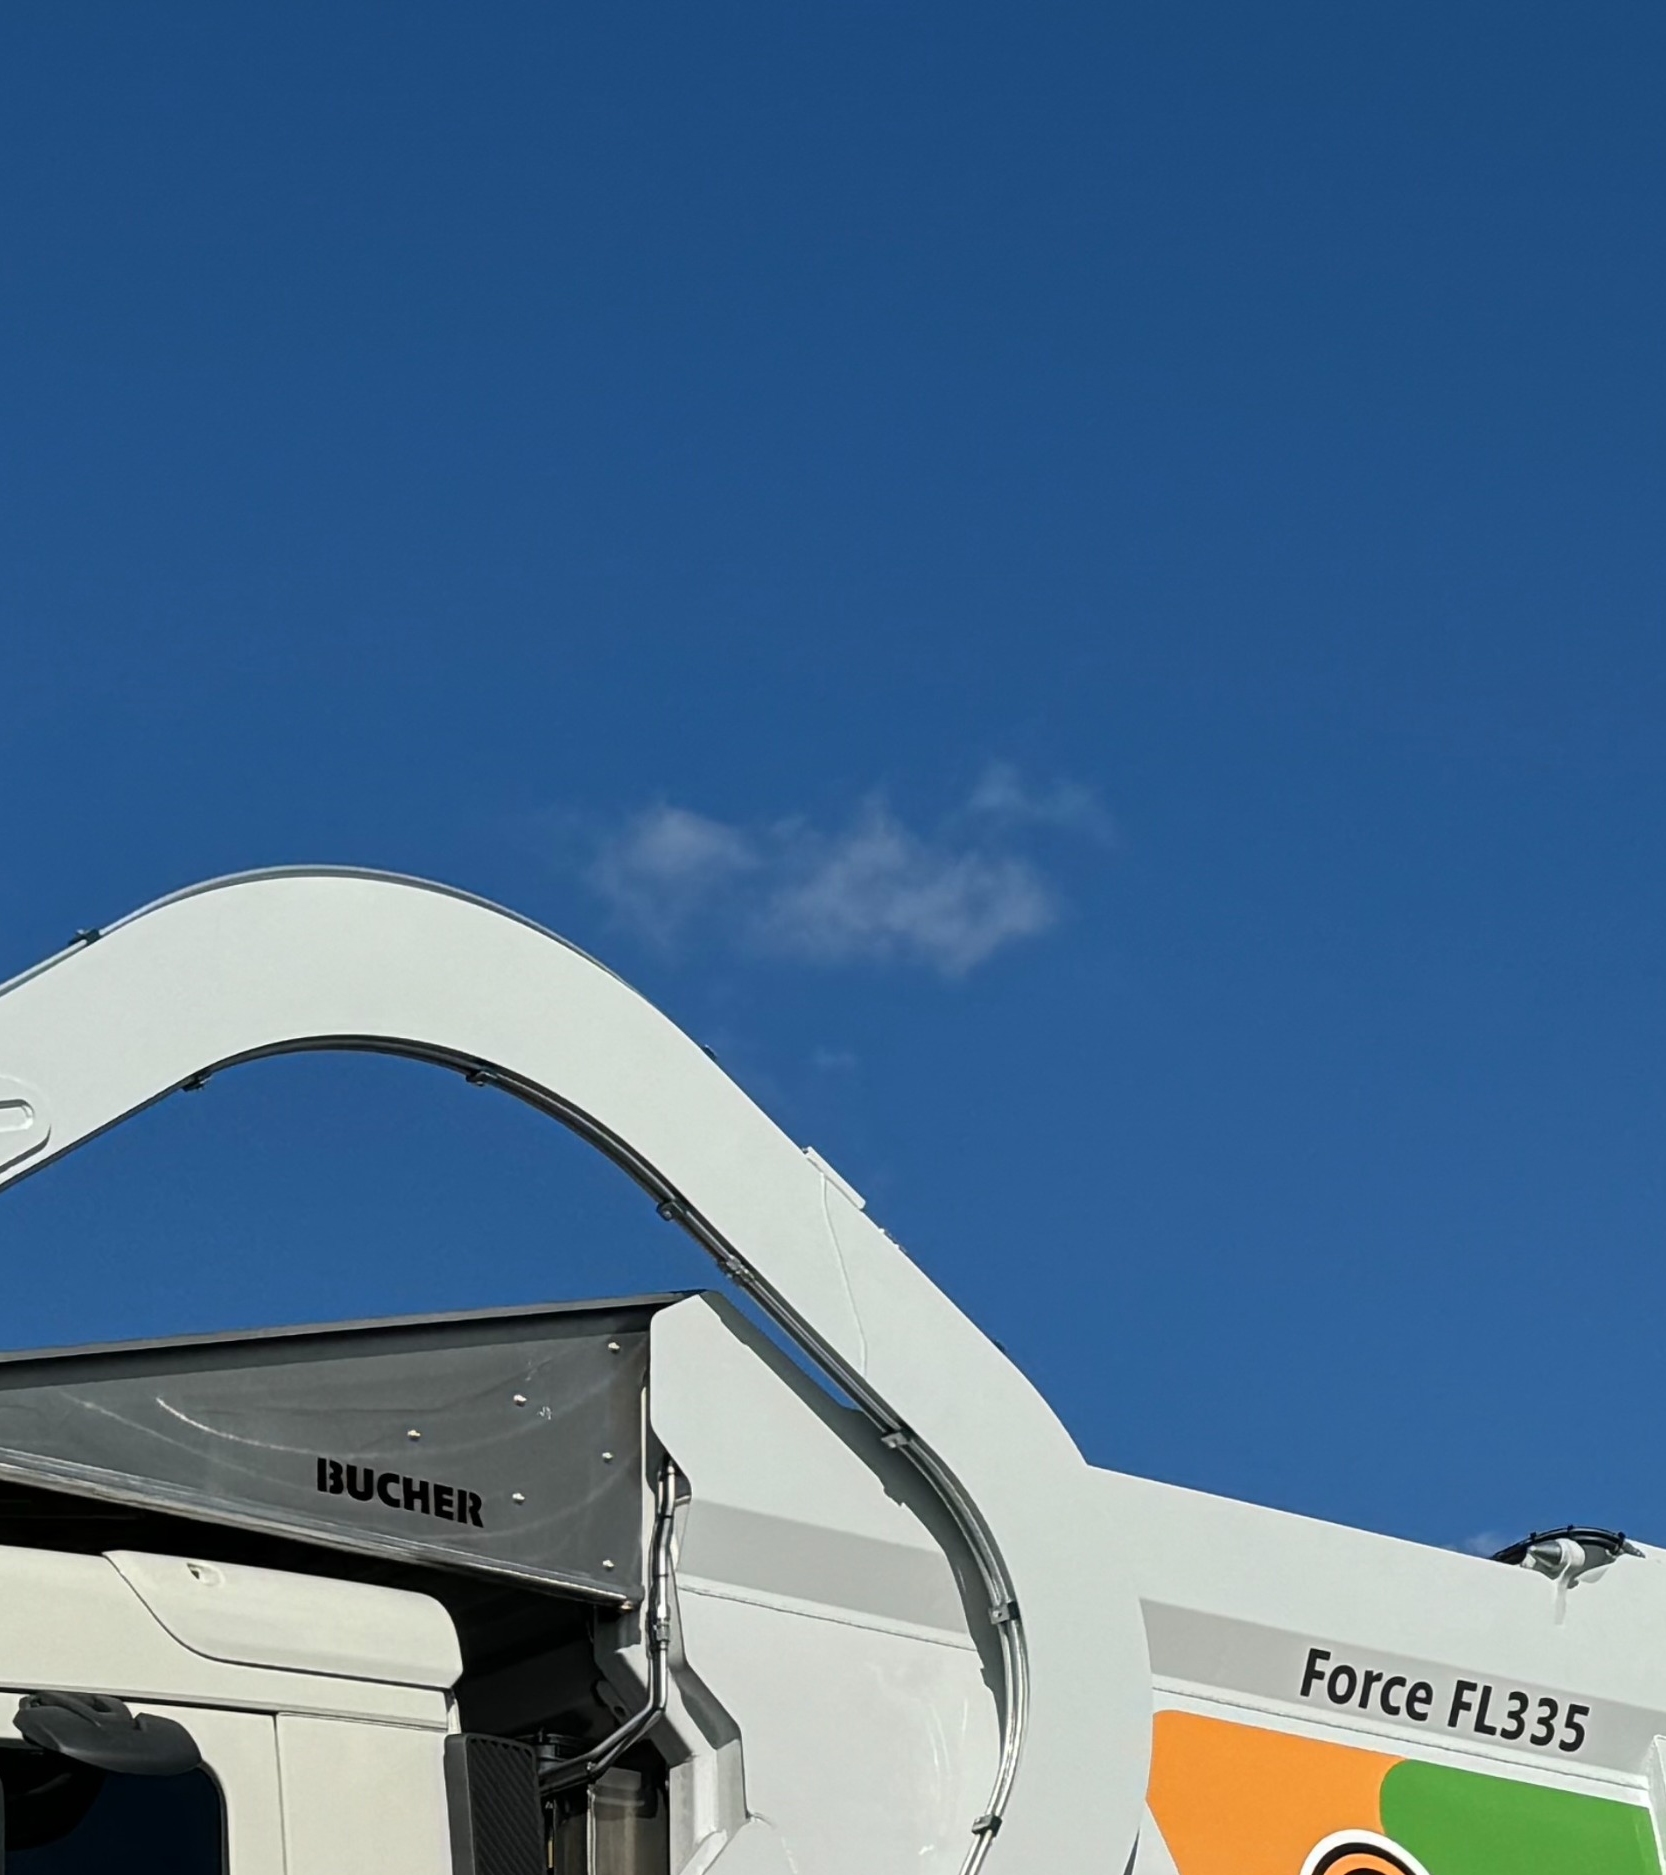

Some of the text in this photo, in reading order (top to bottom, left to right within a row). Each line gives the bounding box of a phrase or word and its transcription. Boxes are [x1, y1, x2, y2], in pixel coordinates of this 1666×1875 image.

[317, 1457, 485, 1528] BUCHER
[1299, 1647, 1591, 1753] Force FL335
